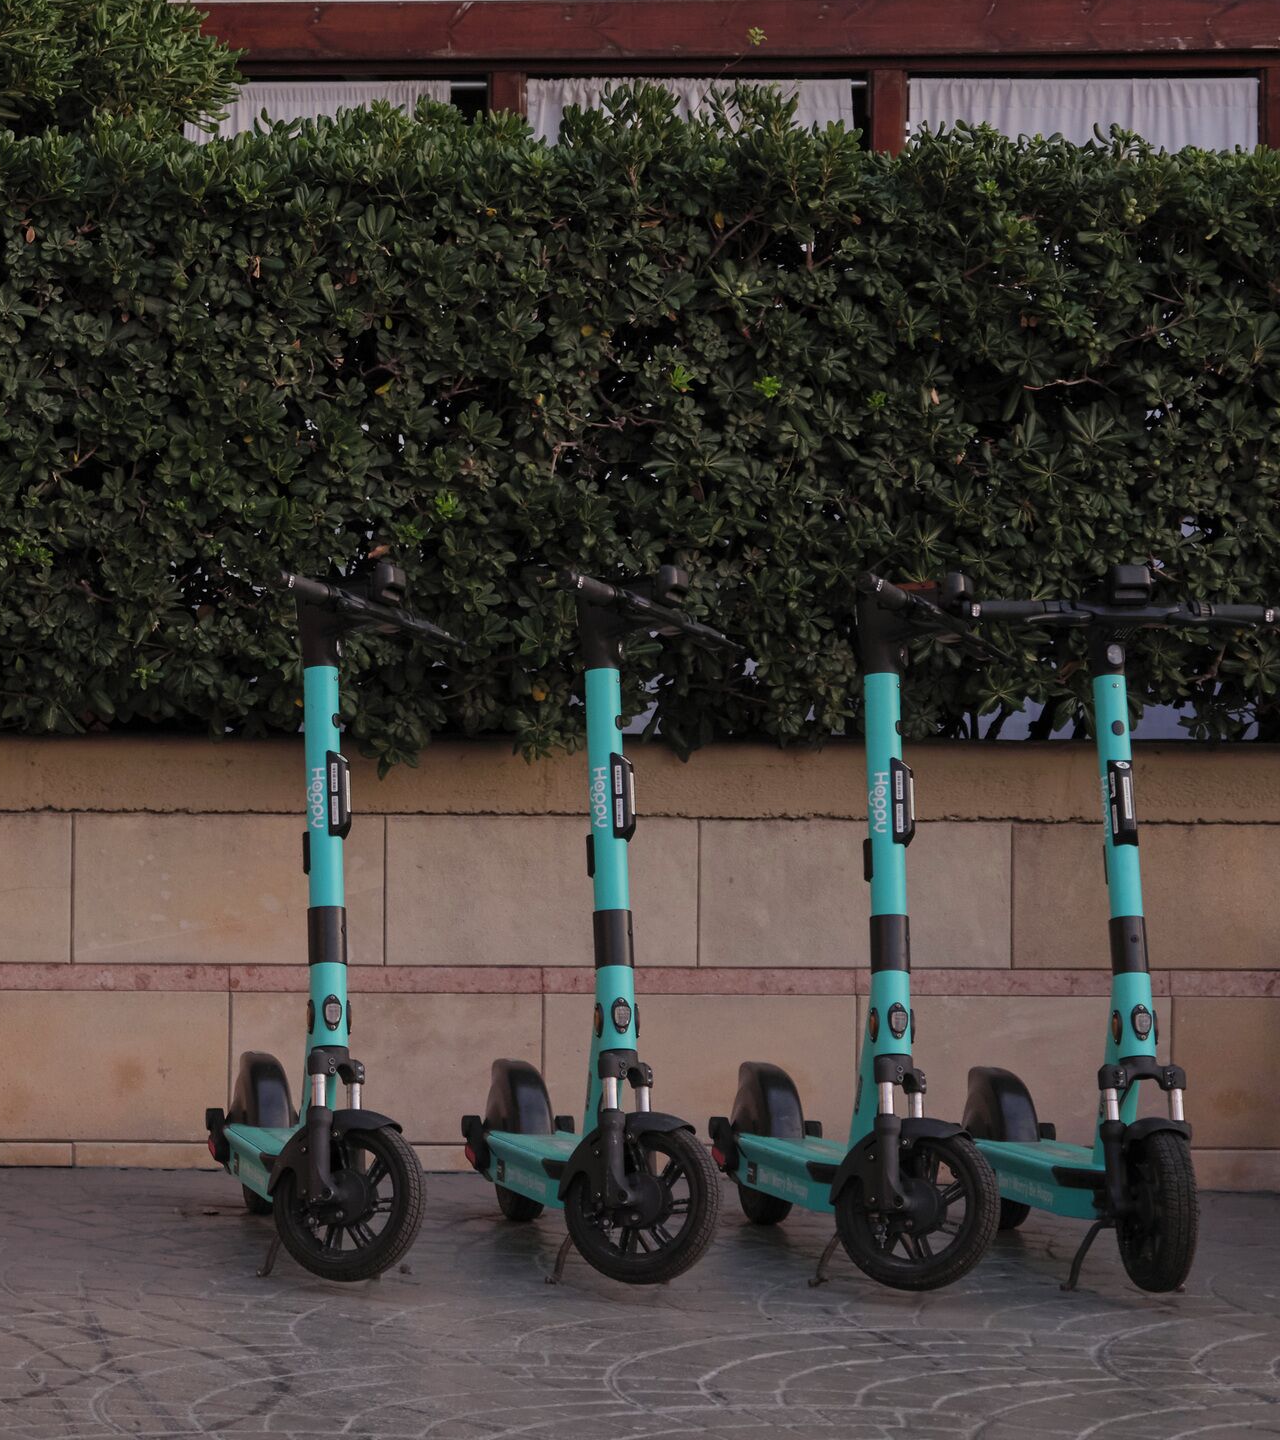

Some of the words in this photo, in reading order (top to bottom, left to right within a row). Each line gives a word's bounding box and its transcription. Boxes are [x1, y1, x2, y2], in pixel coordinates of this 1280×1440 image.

[309, 767, 325, 828] Hoppy
[592, 766, 608, 827] Hoppy
[871, 771, 888, 833] Hoppy
